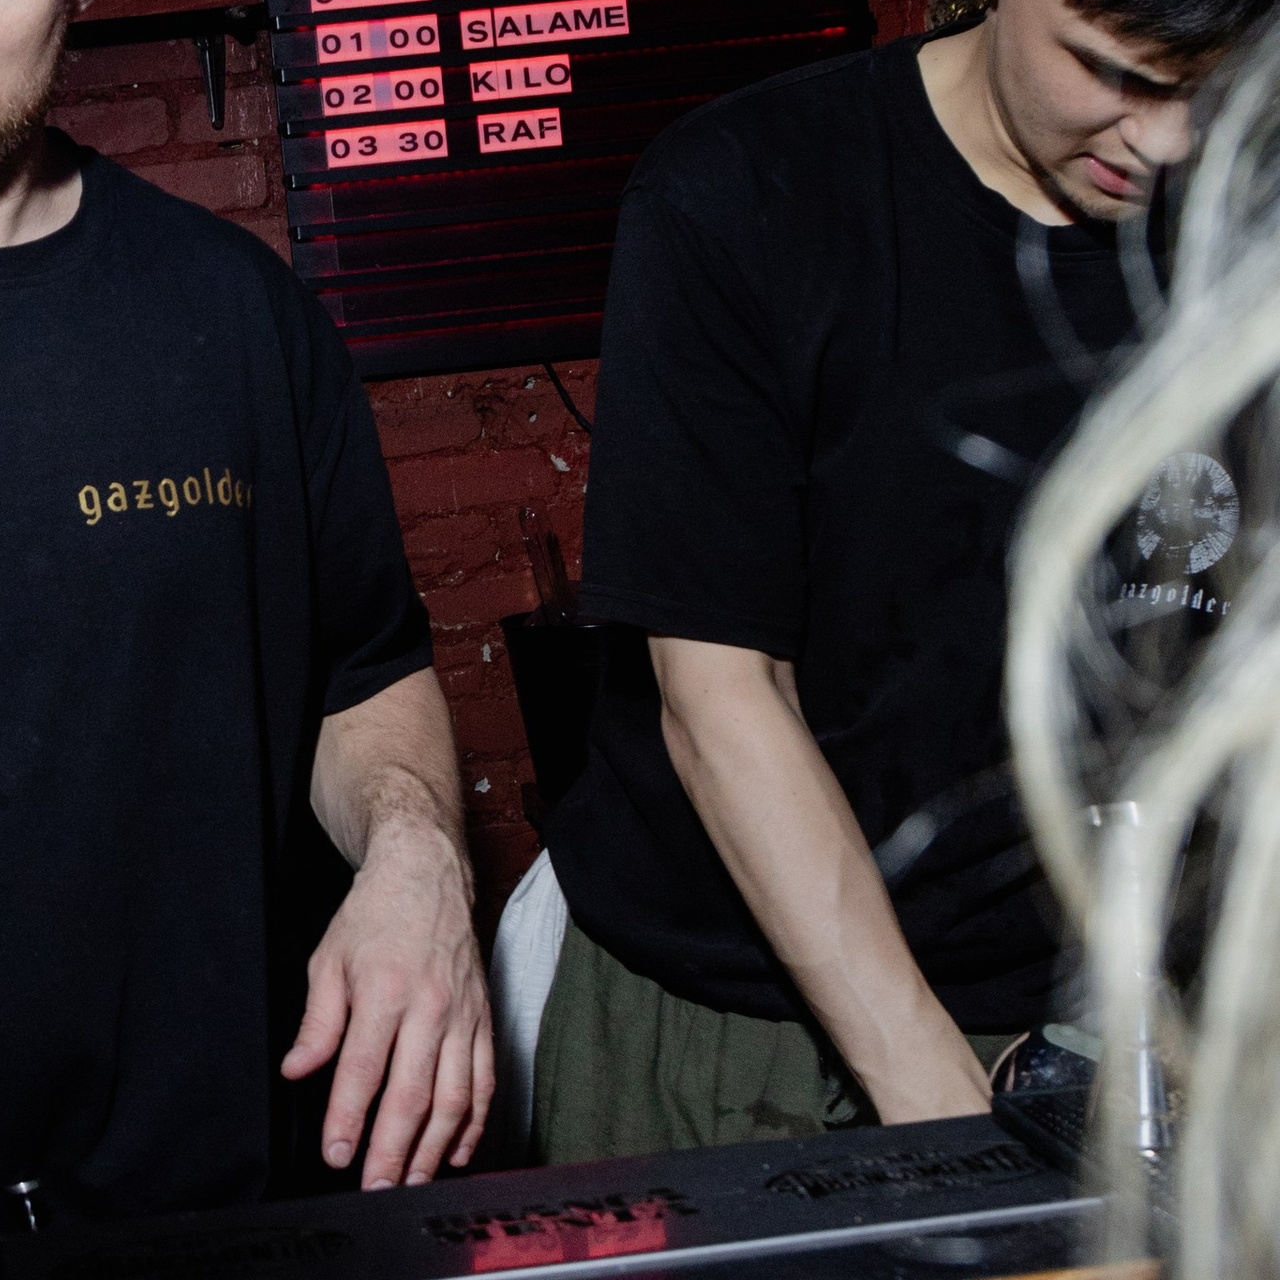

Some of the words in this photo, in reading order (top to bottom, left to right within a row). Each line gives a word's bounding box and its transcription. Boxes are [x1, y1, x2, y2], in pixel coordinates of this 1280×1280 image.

[322, 32, 362, 55] 01
[389, 26, 436, 49] 00
[467, 6, 626, 43] SALAME
[325, 85, 372, 108] 02
[395, 78, 440, 101] 00
[472, 63, 570, 93] KILO
[331, 136, 377, 159] 03
[399, 130, 443, 153] 30
[483, 117, 558, 145] RAF
